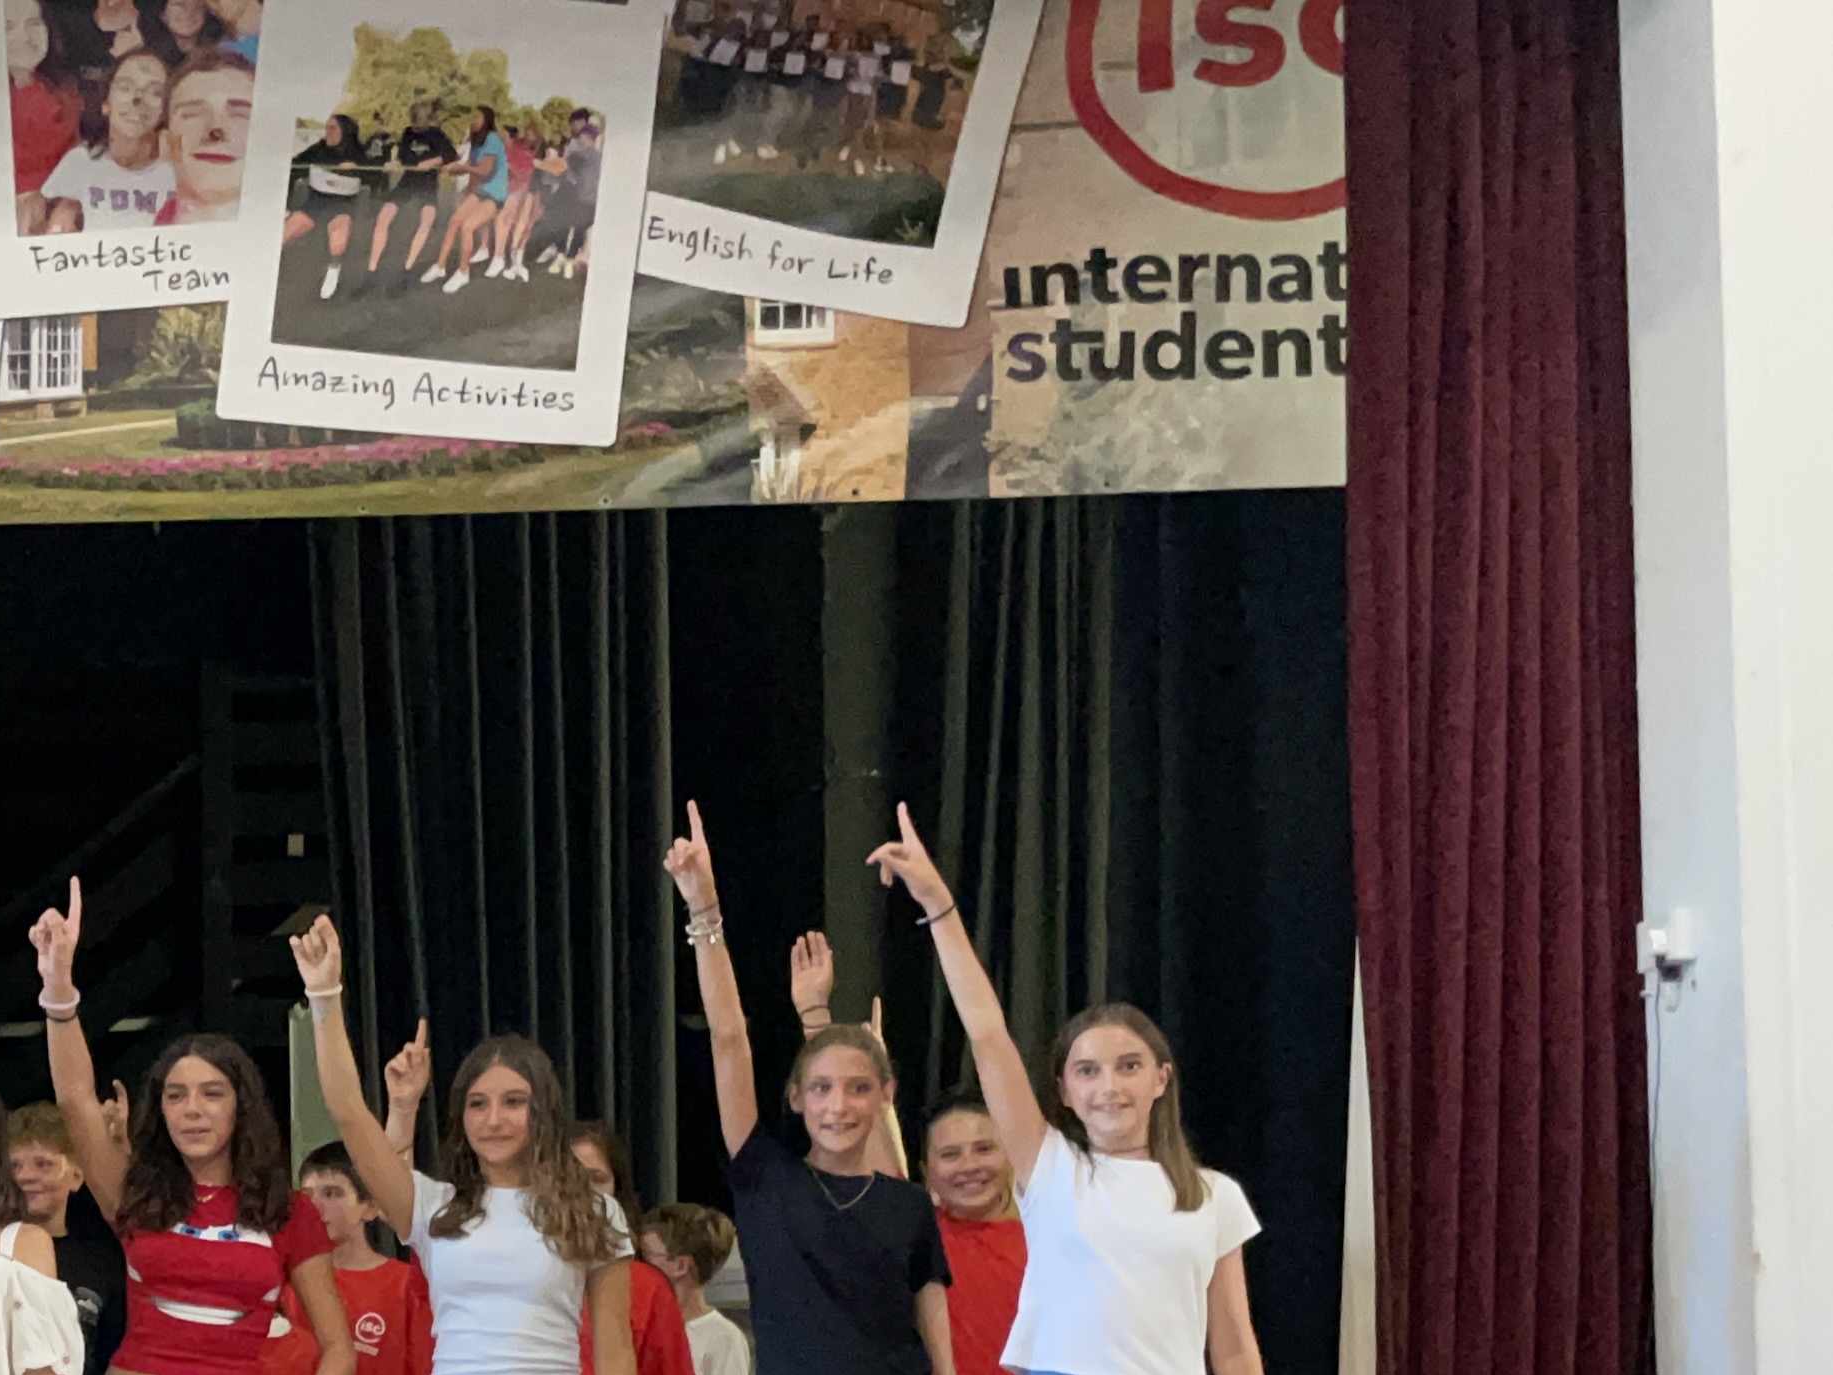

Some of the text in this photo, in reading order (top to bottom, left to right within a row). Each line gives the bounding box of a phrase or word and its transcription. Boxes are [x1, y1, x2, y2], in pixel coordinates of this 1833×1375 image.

[28, 235, 192, 274] Fantastic
[647, 215, 894, 285] English for Life
[142, 269, 231, 292] Team
[1006, 311, 1349, 383] student
[257, 356, 575, 413] Amazing Activities
